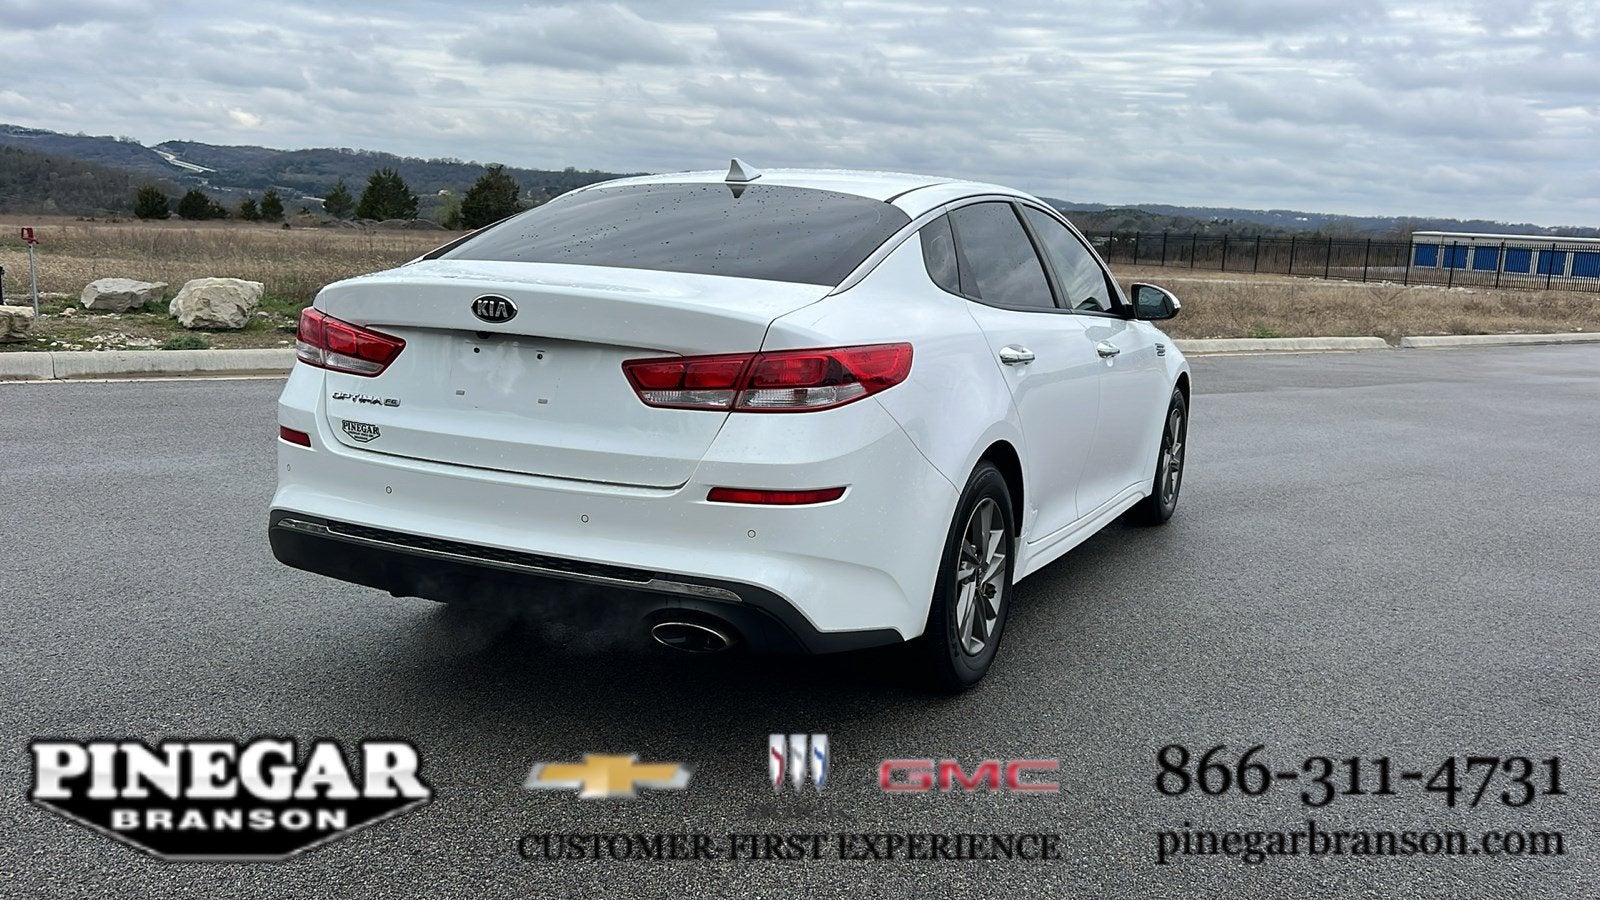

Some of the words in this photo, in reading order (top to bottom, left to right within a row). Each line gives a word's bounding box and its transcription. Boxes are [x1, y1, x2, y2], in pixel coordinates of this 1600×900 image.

[477, 300, 508, 317] KIA
[332, 392, 383, 405] OPTIMA
[343, 422, 380, 434] PINEGAR
